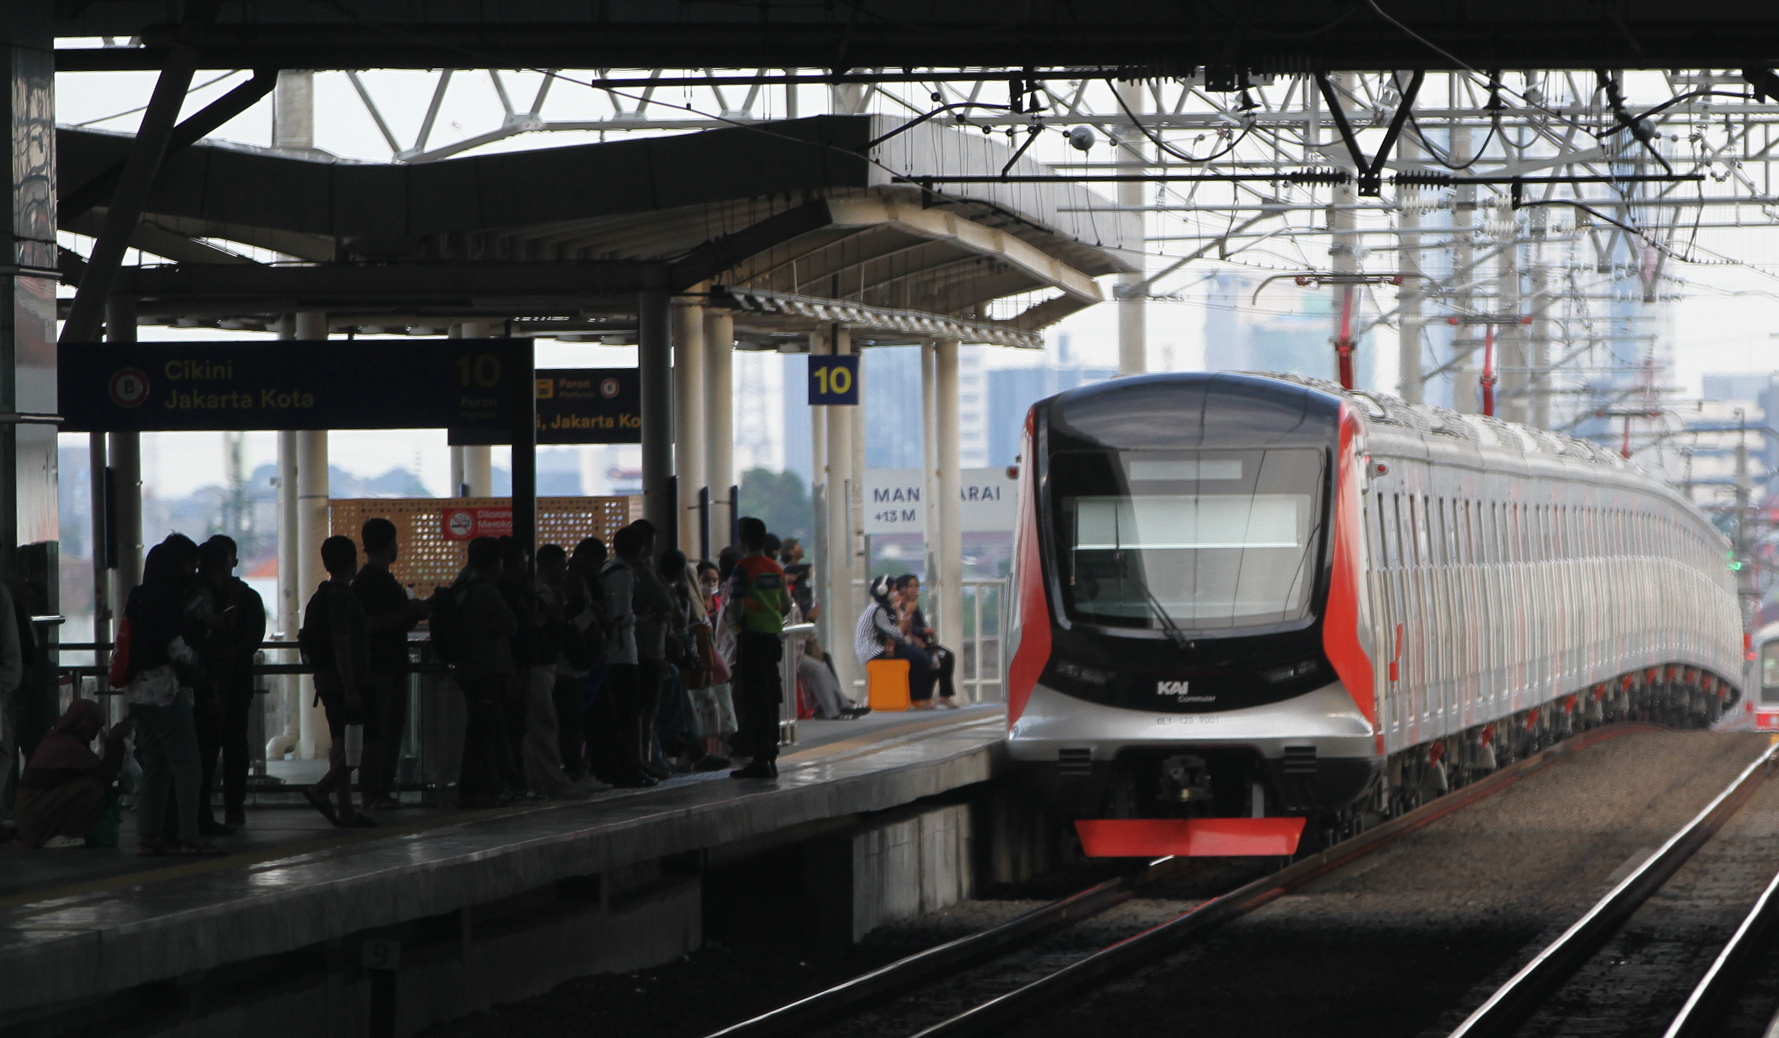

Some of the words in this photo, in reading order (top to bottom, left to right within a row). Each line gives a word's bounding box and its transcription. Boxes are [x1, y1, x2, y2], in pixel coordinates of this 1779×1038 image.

[164, 359, 233, 380] Cikini
[455, 354, 501, 388] 10
[123, 379, 135, 394] B
[559, 378, 591, 389] Peron
[814, 366, 852, 394] 10
[164, 389, 253, 410] Jakarta
[261, 388, 314, 408] Kota
[461, 396, 497, 408] Peron
[551, 412, 615, 429] Jakarta
[874, 510, 898, 522] +13
[902, 509, 916, 521] M
[1157, 681, 1189, 695] KAI
[1177, 695, 1216, 703] Commuter
[373, 942, 389, 966] 9
